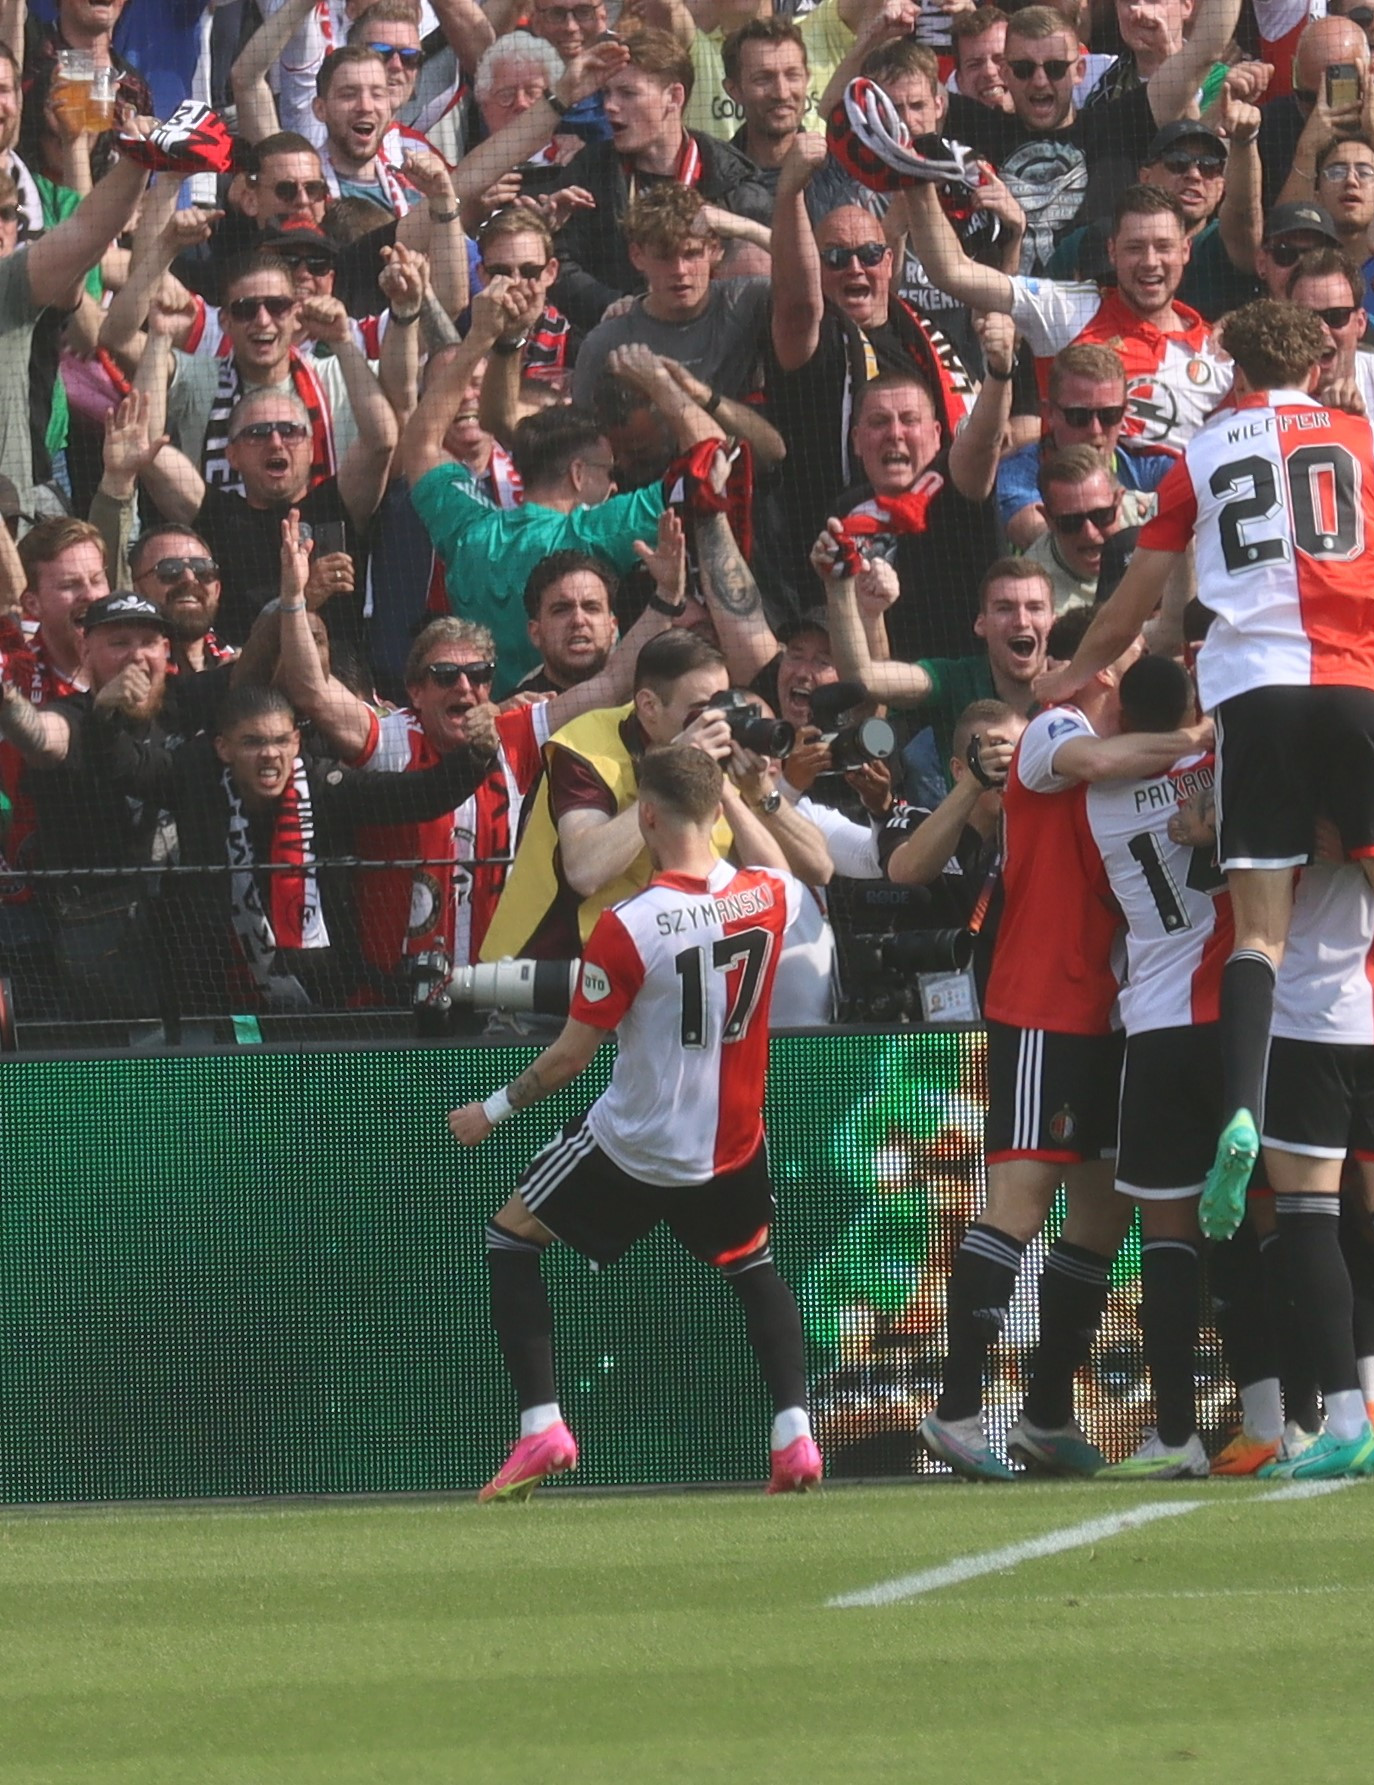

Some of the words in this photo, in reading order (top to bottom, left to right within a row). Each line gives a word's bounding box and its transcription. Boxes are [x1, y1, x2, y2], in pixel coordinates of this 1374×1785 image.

[1226, 411, 1332, 445] WIEFFER
[1208, 442, 1365, 576] 20
[675, 926, 775, 1050] 17
